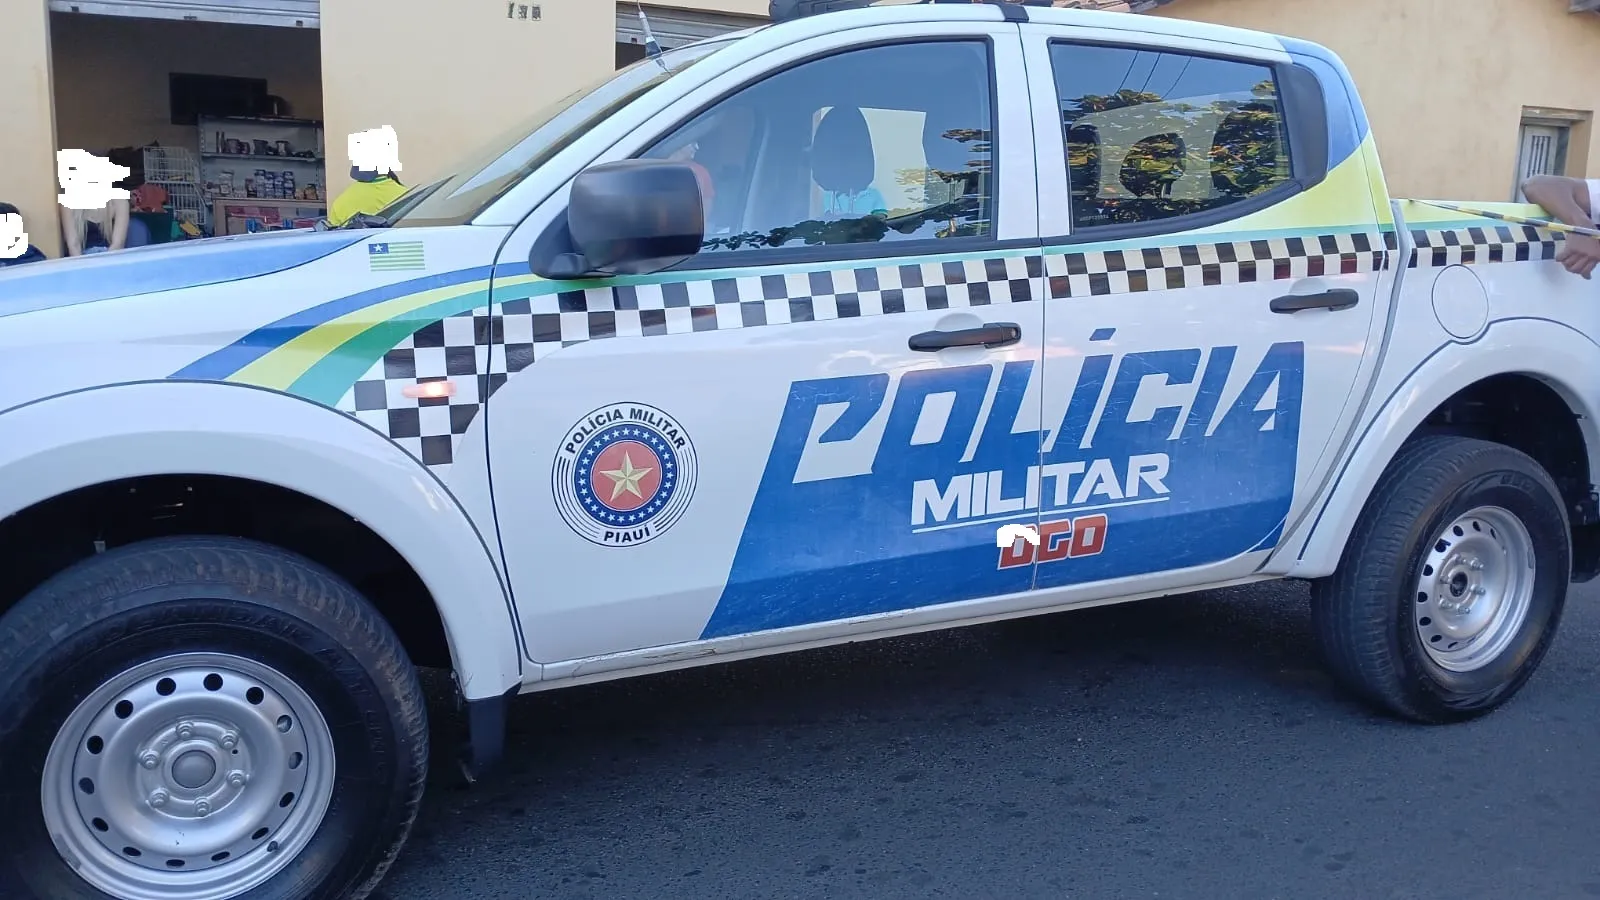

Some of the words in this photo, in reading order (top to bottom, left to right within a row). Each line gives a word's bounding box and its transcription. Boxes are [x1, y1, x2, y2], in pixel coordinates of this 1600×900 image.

[565, 408, 624, 454] POLÍCIA
[629, 407, 686, 449] MILITAR
[780, 328, 1304, 483] POLÍCIA
[911, 453, 1170, 526] MILITAR
[603, 524, 651, 543] PIAUÍ
